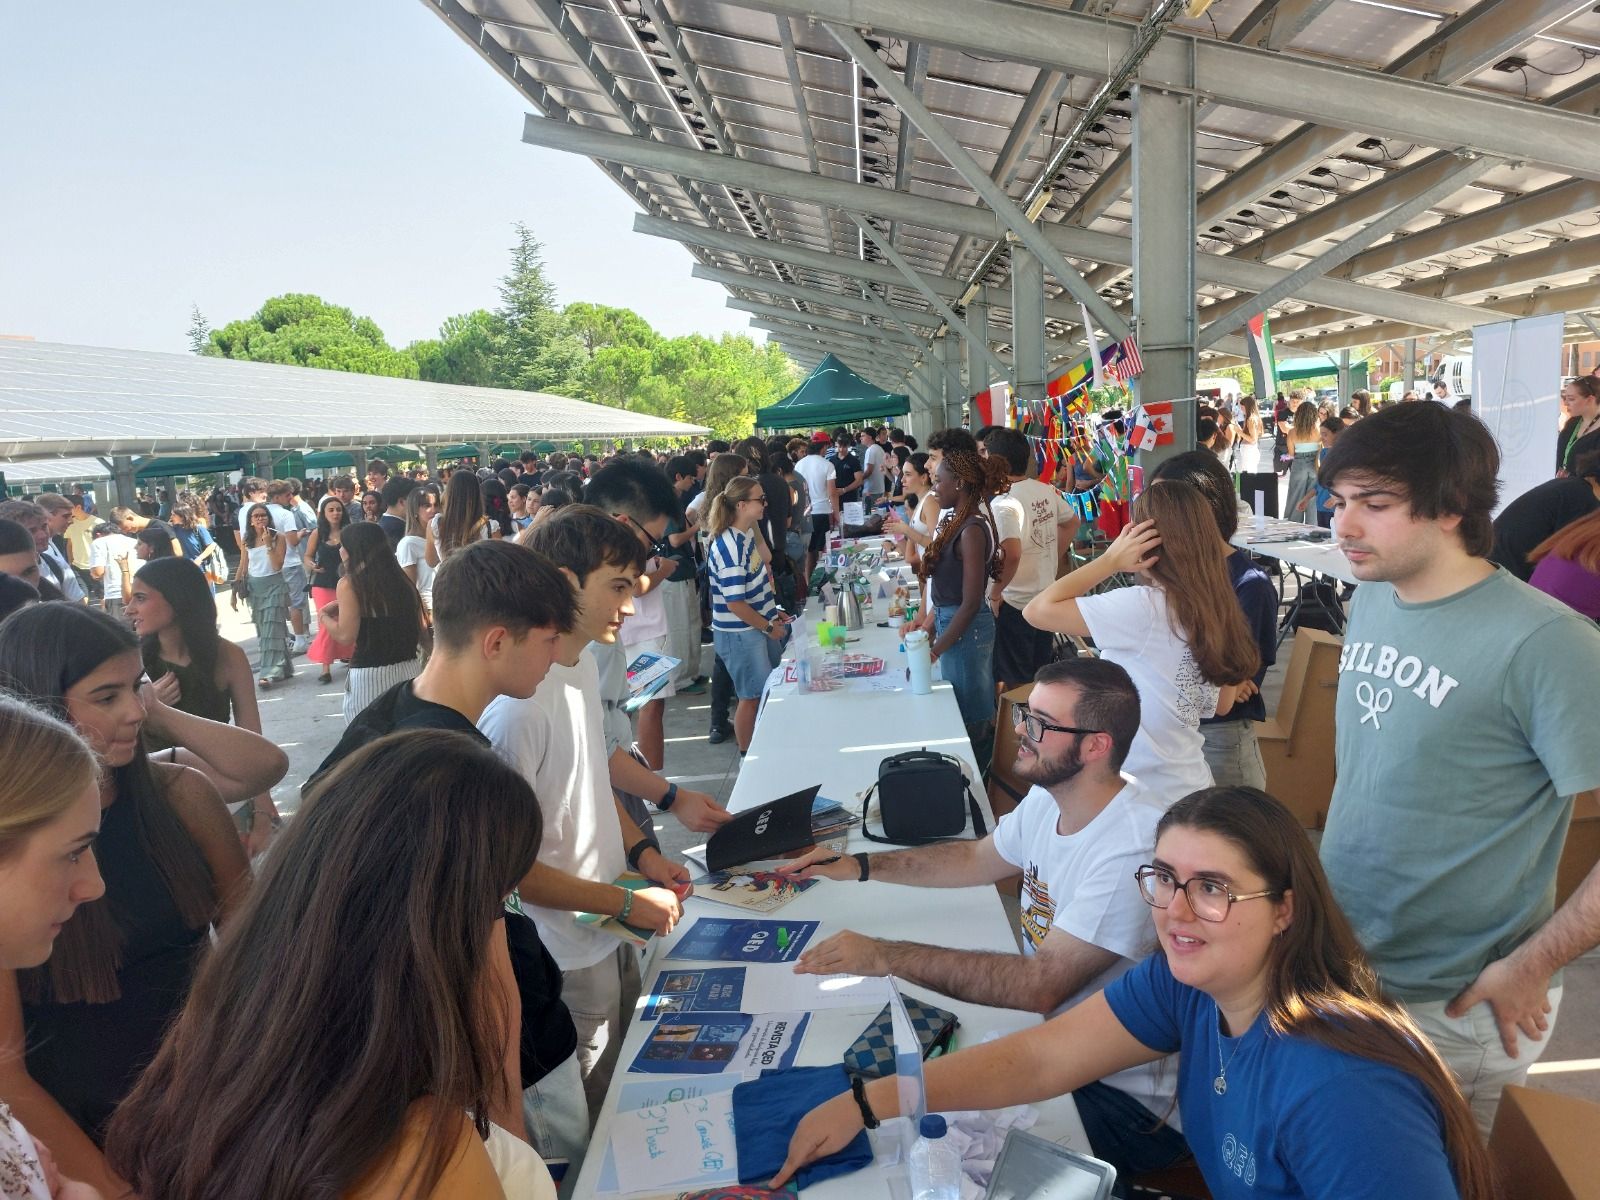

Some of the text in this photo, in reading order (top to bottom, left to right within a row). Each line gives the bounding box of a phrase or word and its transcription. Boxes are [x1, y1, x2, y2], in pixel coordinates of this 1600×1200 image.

[1338, 642, 1460, 709] SILBON
[754, 809, 772, 835] QED
[742, 930, 770, 953] QED
[766, 1021, 788, 1050] REVISTA
[760, 1050, 776, 1066] QED
